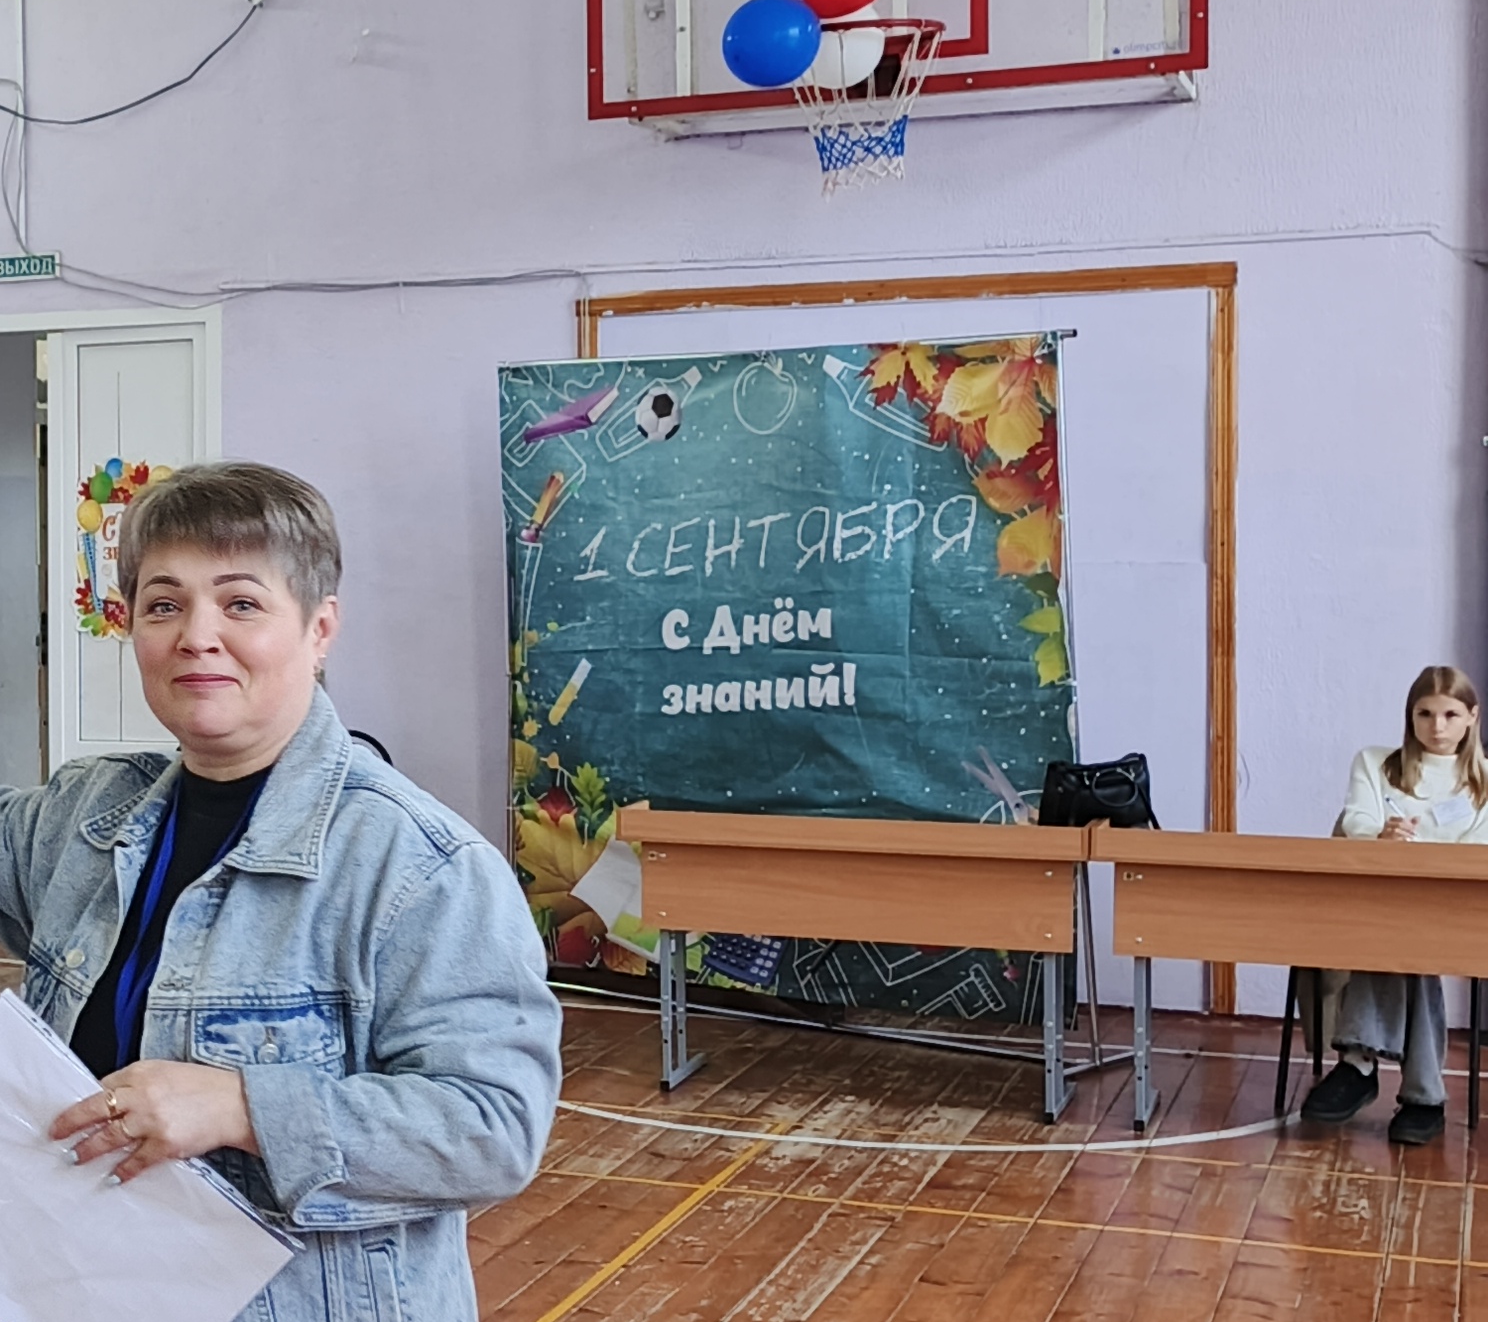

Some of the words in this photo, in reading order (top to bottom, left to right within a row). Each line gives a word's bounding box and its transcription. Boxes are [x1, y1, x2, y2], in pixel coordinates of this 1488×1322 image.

[574, 527, 608, 581] 1
[626, 494, 977, 577] СЕНТЯБРЯ
[702, 597, 832, 655] Днём
[661, 662, 857, 715] знаний!
